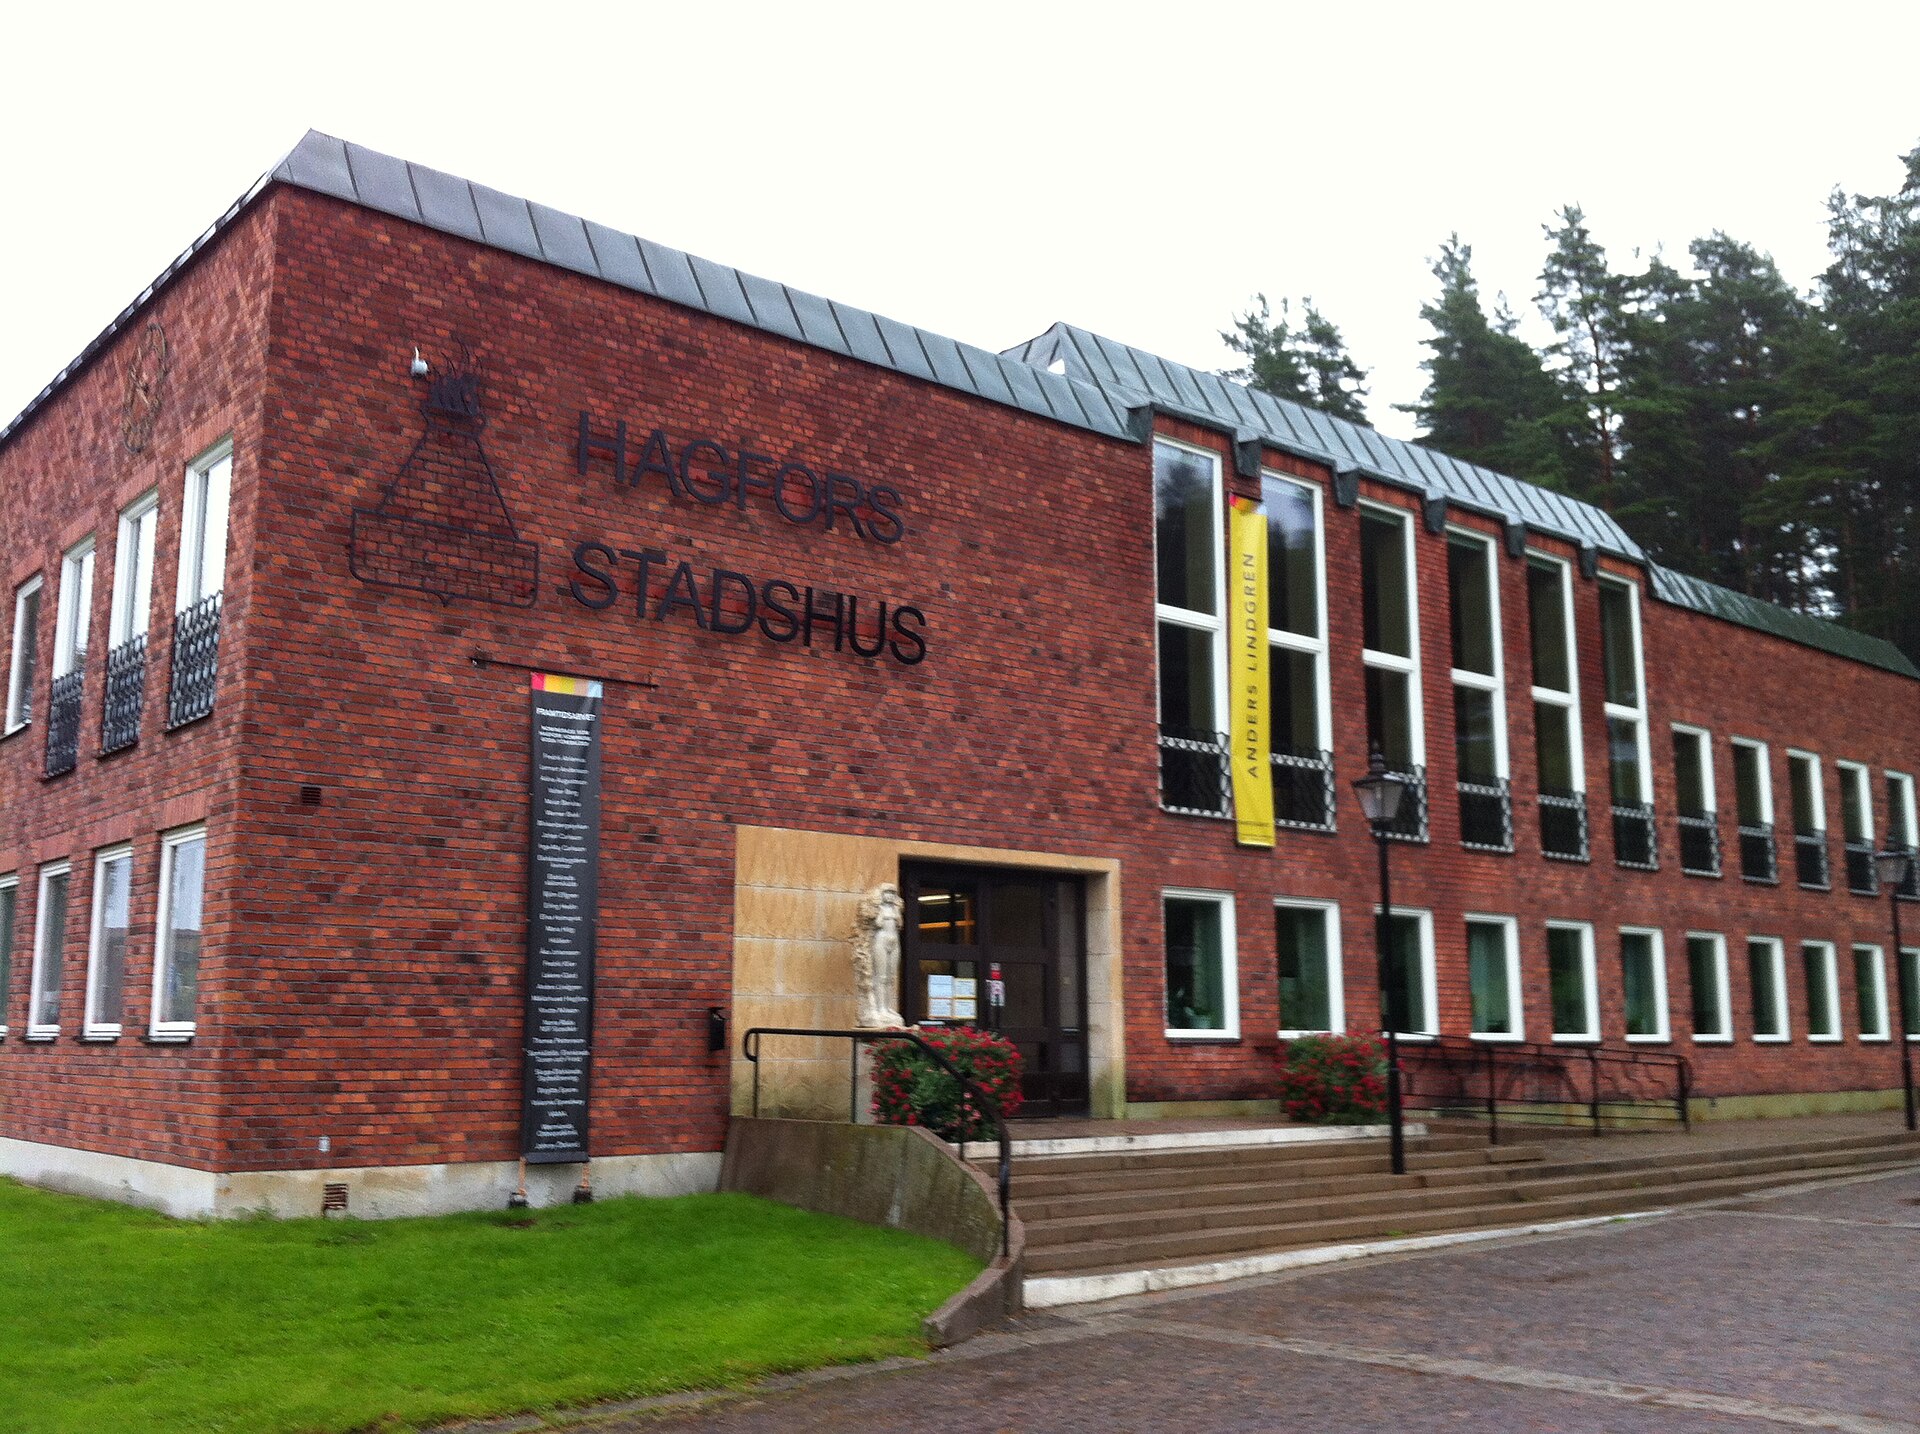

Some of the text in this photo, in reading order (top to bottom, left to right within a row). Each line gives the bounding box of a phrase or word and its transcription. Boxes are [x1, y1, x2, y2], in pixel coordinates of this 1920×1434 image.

[577, 410, 905, 544] HAGFORS
[569, 541, 927, 666] STADSHUS
[1243, 553, 1259, 778] ANDERS LINDGREN
